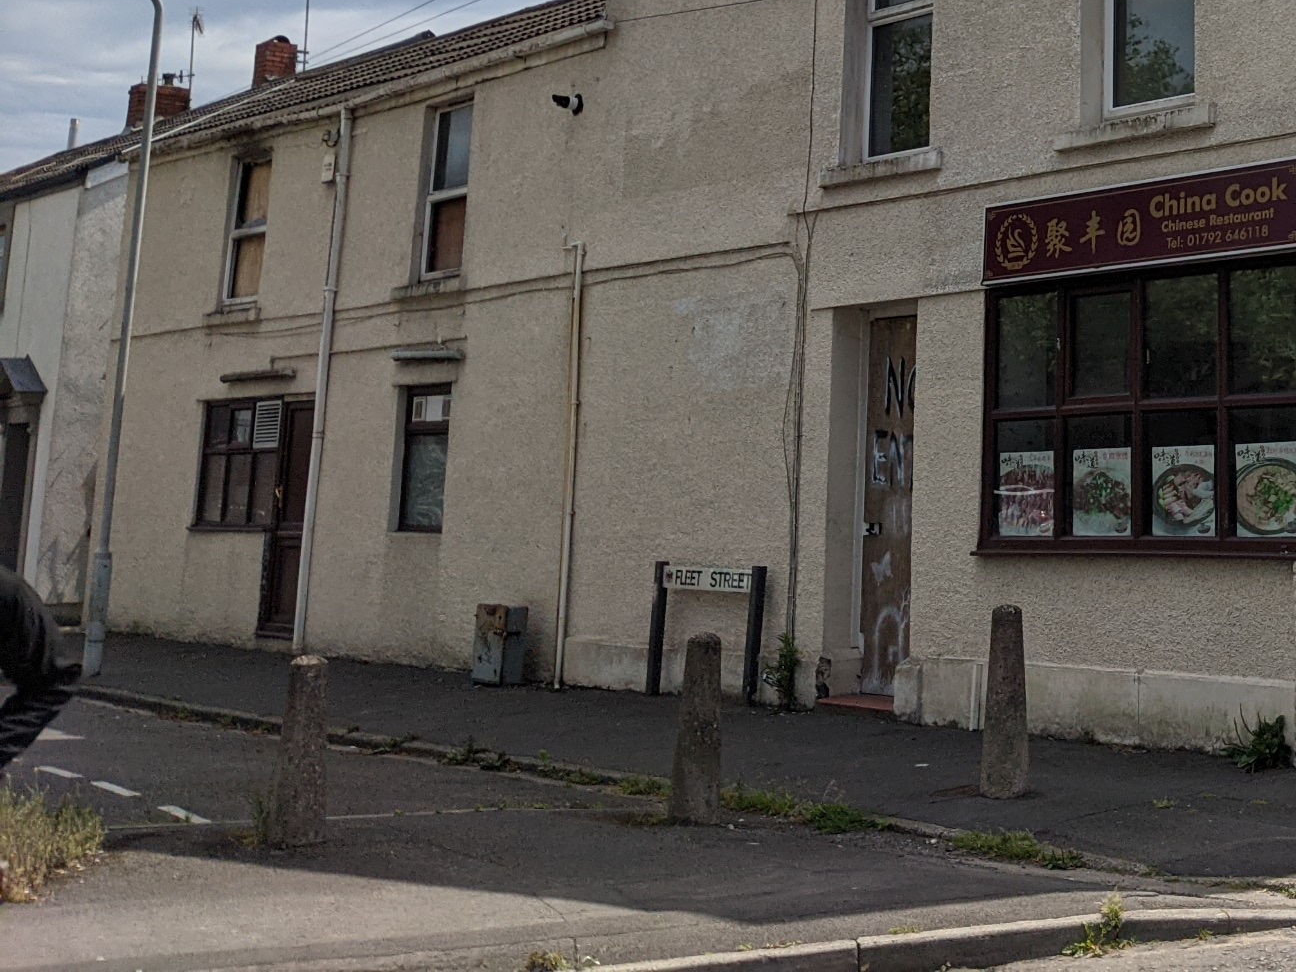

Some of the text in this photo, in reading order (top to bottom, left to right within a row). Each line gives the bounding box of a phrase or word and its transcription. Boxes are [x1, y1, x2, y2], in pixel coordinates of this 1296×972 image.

[1149, 177, 1288, 218] China Cook
[1161, 208, 1275, 232] Chinese Restaurant
[1167, 225, 1269, 249] Tel: 01792 646118
[675, 570, 752, 589] FLEET STREET
